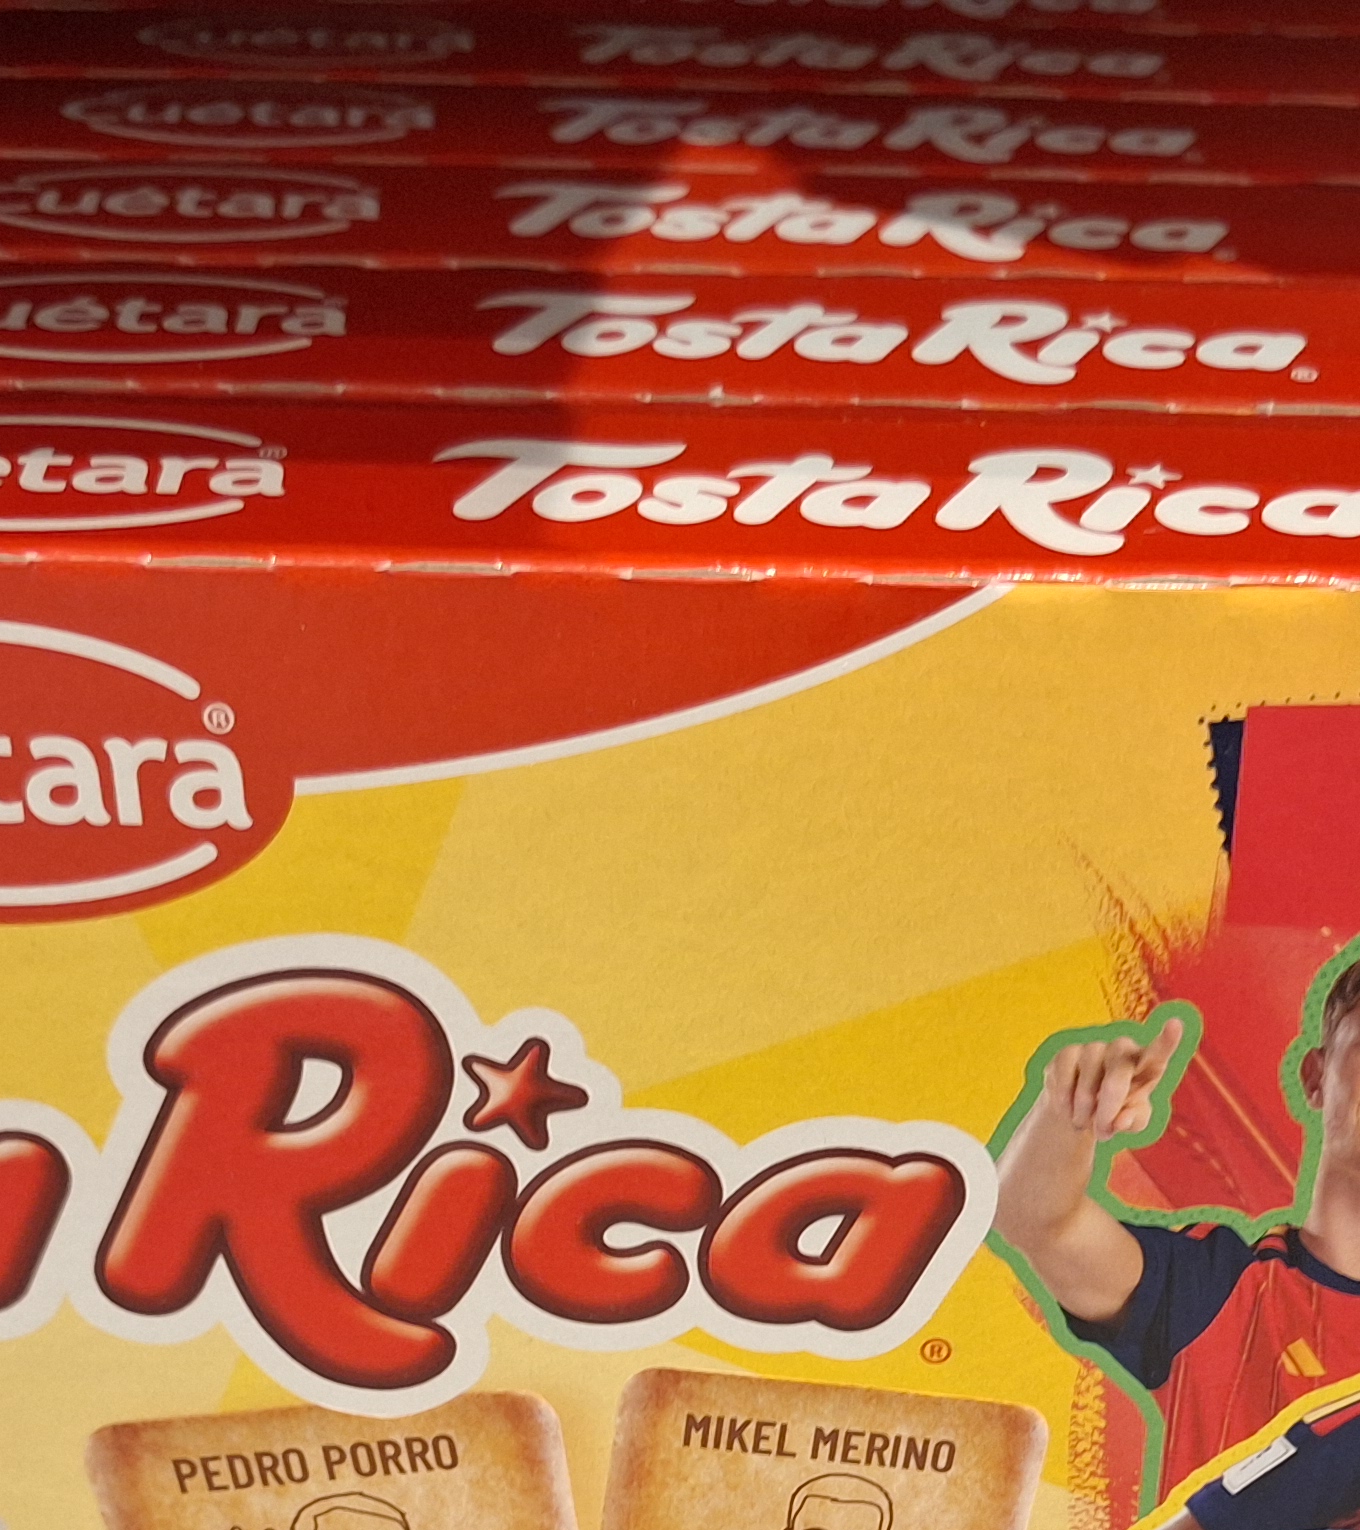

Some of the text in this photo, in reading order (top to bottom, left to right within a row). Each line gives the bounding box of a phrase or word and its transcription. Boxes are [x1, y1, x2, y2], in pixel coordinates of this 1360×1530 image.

[495, 182, 1230, 262] Tosta Rica
[477, 290, 1308, 386] Tosta Rica
[432, 437, 932, 530] Tosta
[92, 967, 968, 1391] Rica
[171, 1433, 460, 1494] PEDRO PORRO
[682, 1412, 958, 1475] MIKEL MERINO
